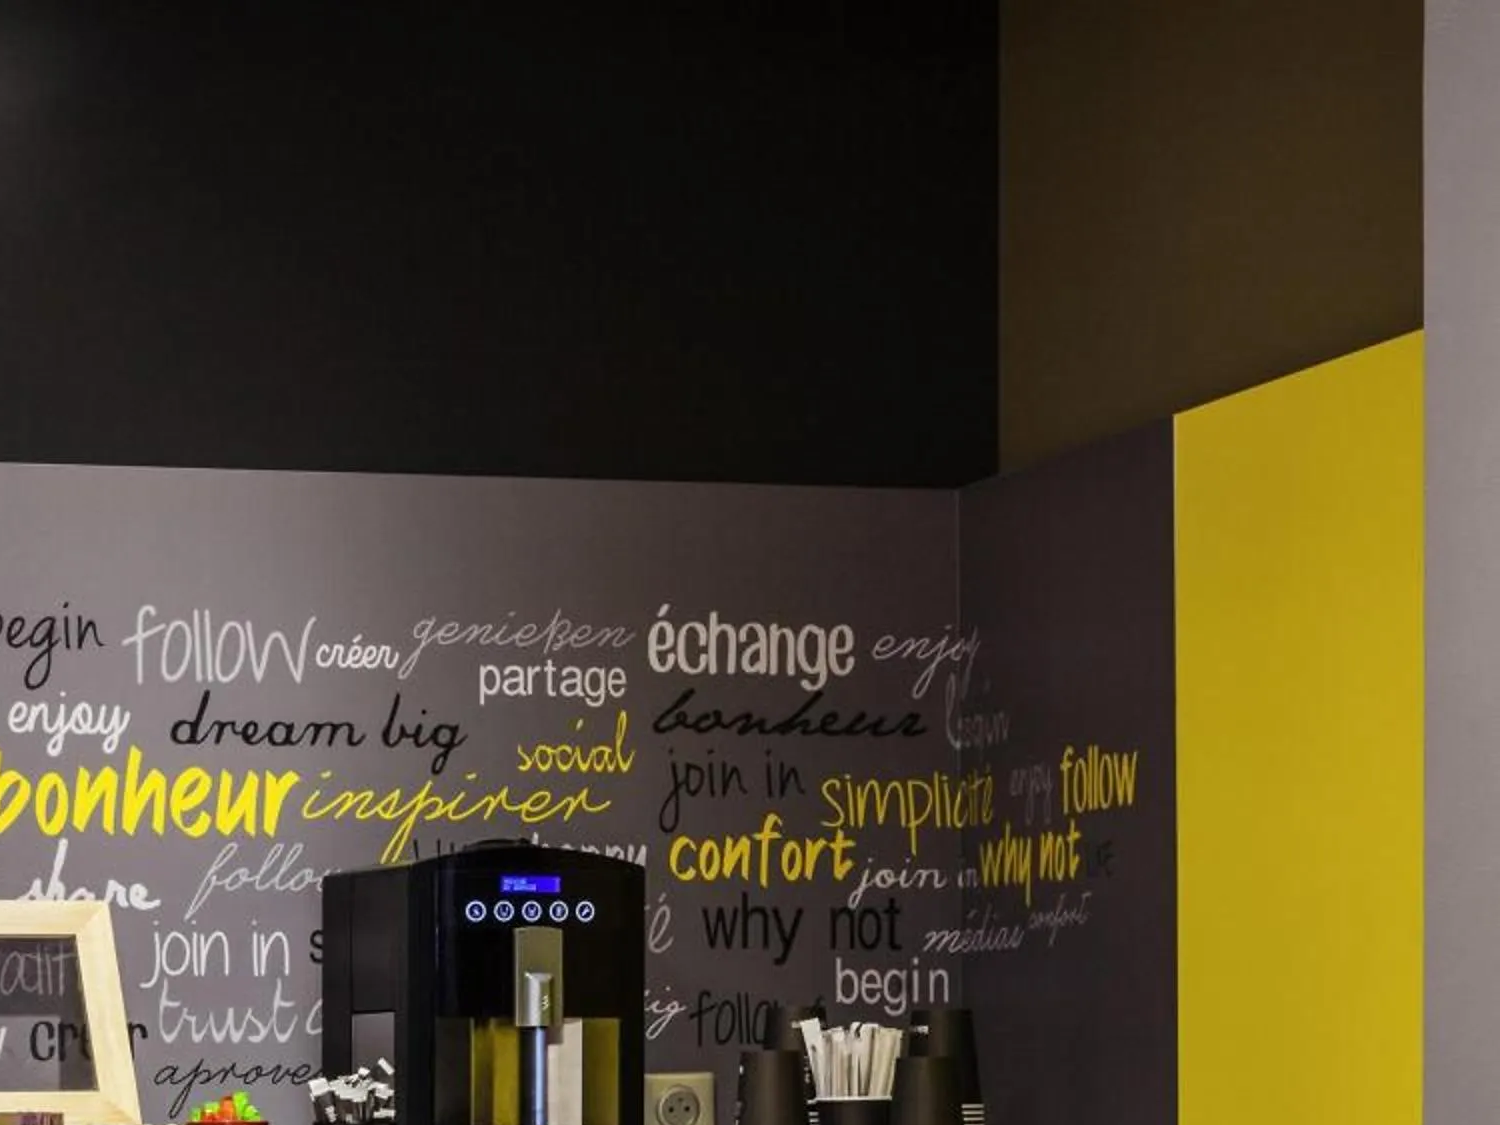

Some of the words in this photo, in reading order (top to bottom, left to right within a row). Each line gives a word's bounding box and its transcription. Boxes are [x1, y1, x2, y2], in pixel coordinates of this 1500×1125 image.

[122, 605, 317, 685] follow
[315, 633, 400, 669] créer
[647, 603, 855, 691] échange
[871, 620, 980, 699] enjoy
[480, 661, 627, 706] partage
[652, 687, 927, 738] bonheur
[8, 691, 130, 757] enjoy
[170, 690, 365, 748] dream
[381, 694, 468, 775] big
[517, 710, 636, 774] social
[658, 748, 748, 834] join
[763, 748, 805, 799] in
[820, 760, 994, 856] simplicité
[1060, 744, 1140, 815] follow
[301, 769, 613, 866] inspirer
[669, 813, 857, 888] confort
[847, 857, 947, 909] join
[980, 821, 1032, 906] why
[1039, 818, 1082, 882] not
[139, 919, 230, 988] join
[252, 919, 290, 977] in
[702, 891, 804, 966] why
[829, 898, 902, 952] not
[159, 978, 299, 1043] trust
[835, 957, 950, 1016] begin
